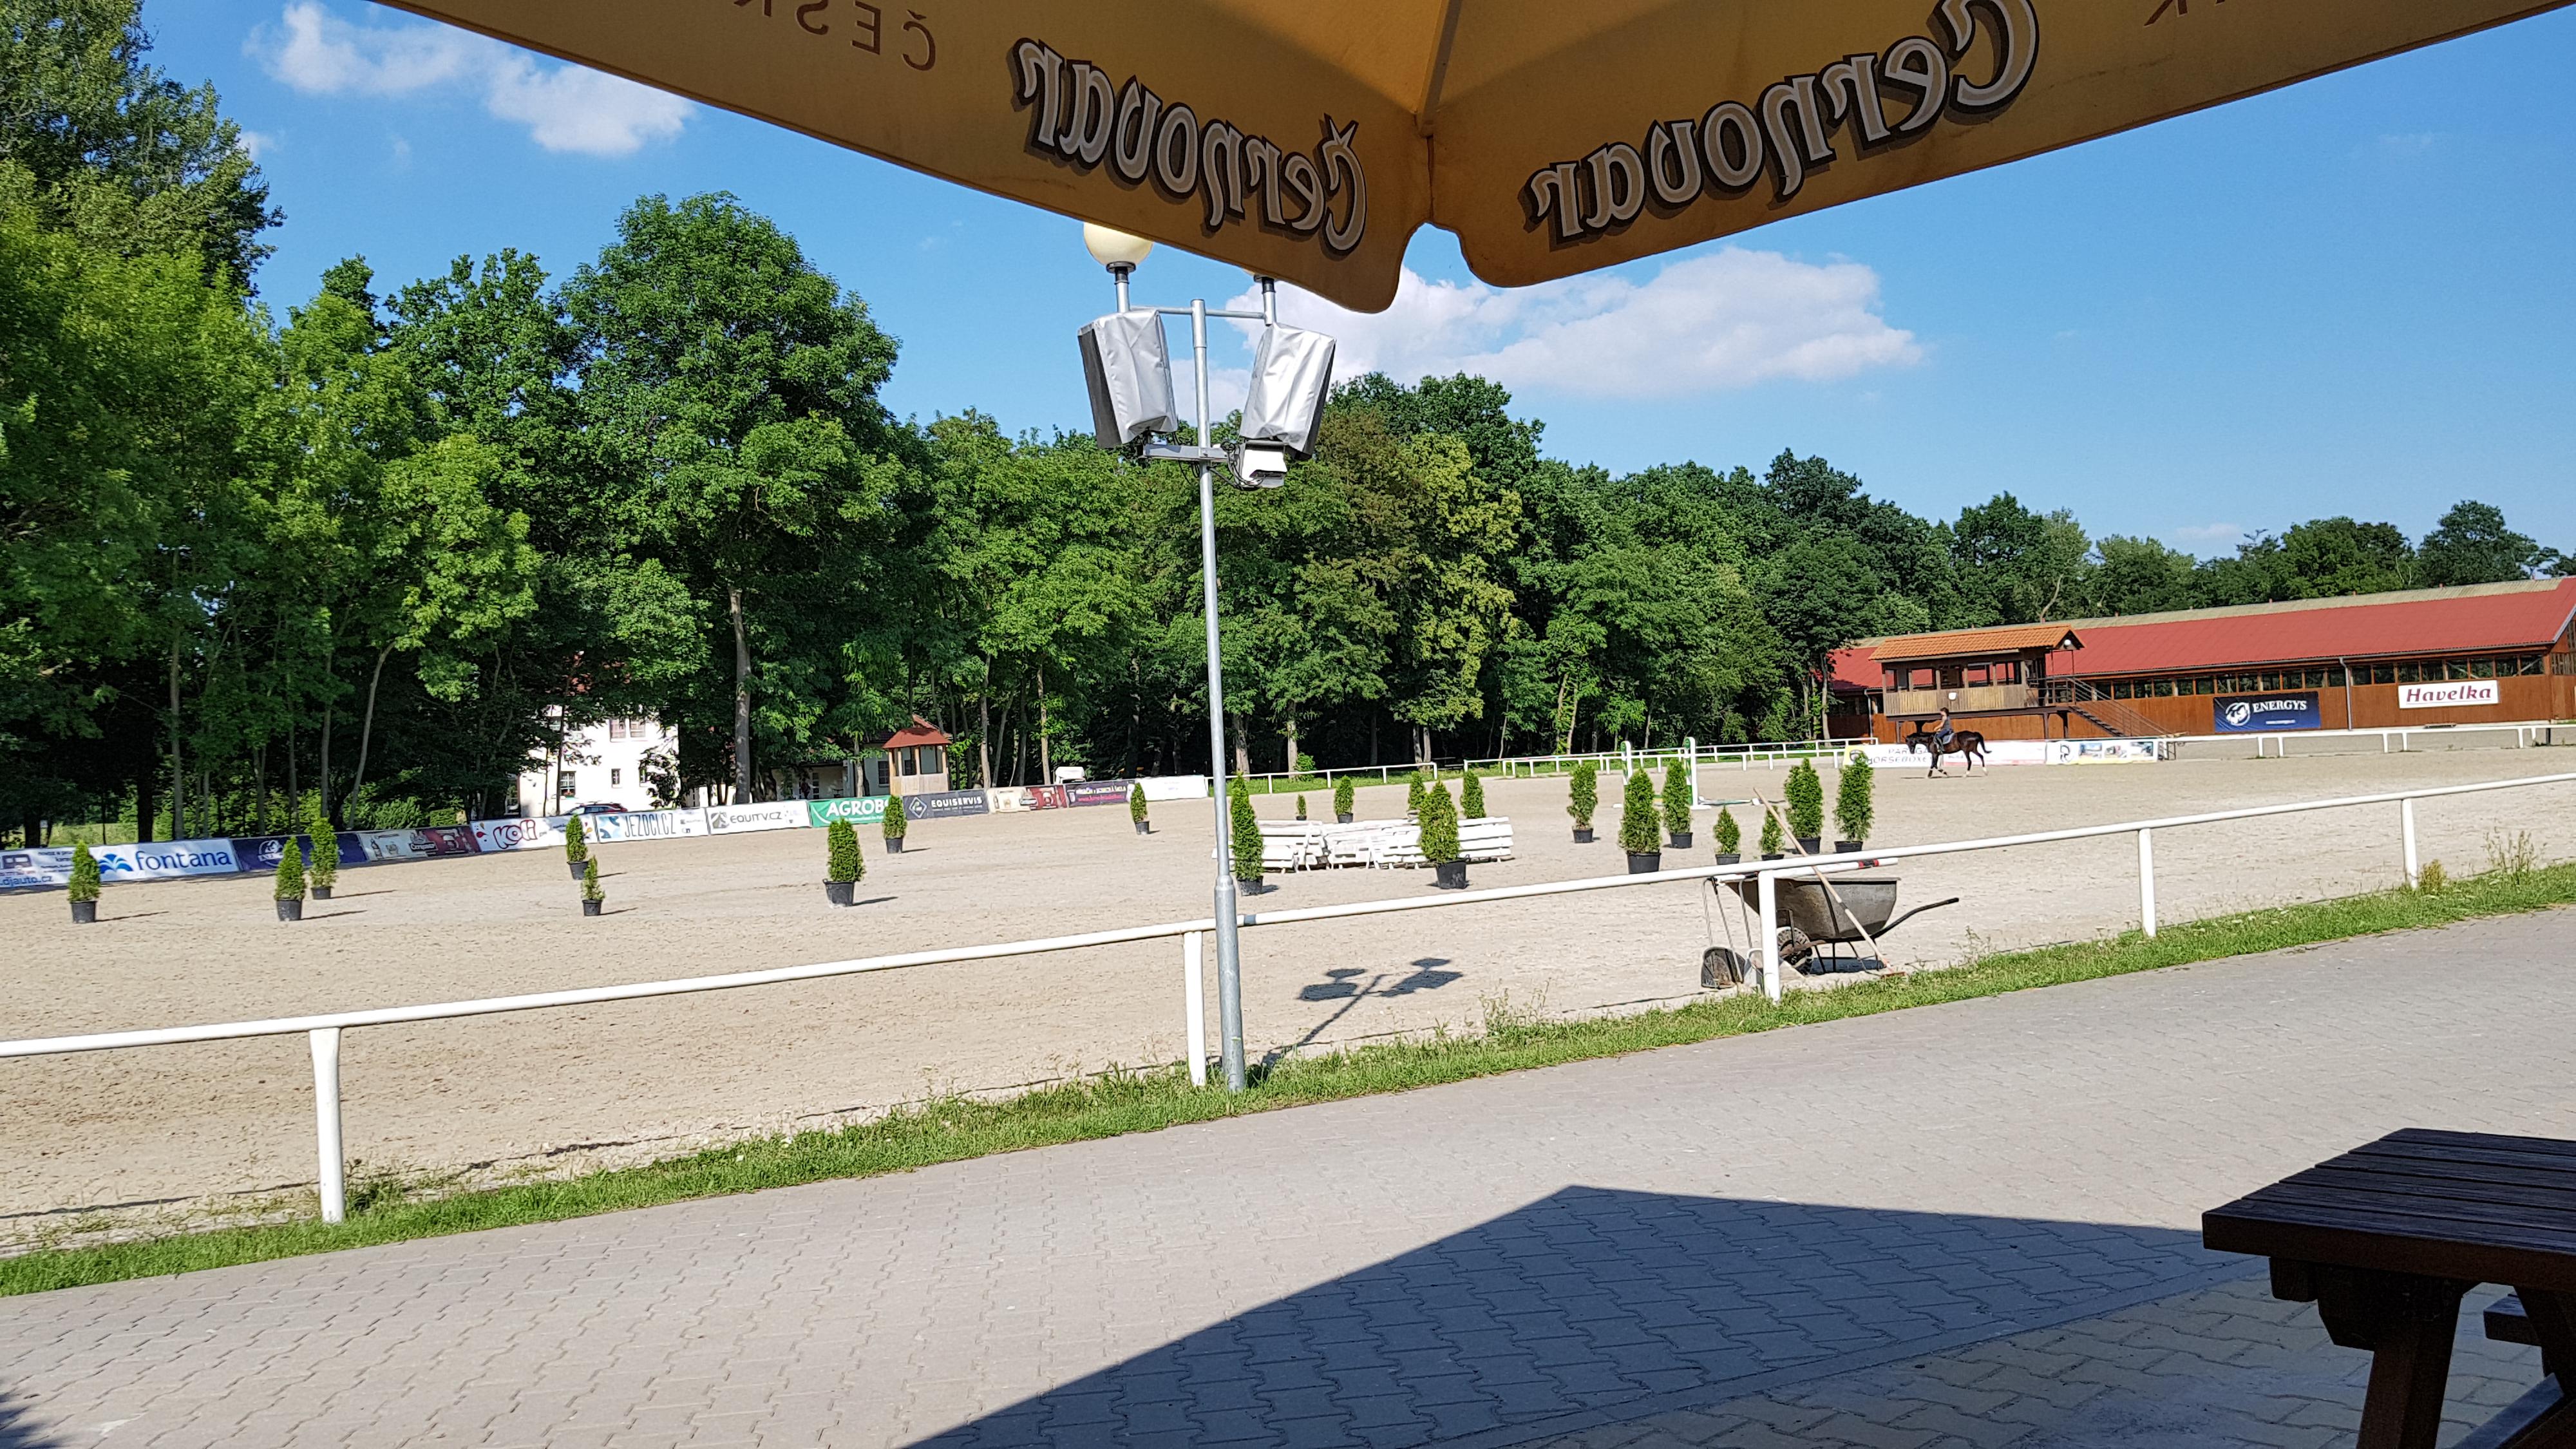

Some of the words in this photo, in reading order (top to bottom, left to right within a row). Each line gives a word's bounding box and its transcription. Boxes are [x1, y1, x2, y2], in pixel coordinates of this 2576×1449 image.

[2406, 685, 2492, 703] Havelka
[2252, 700, 2307, 713] ENERGYS
[931, 796, 983, 808] EQUISERVIS
[135, 844, 232, 871] fontana
